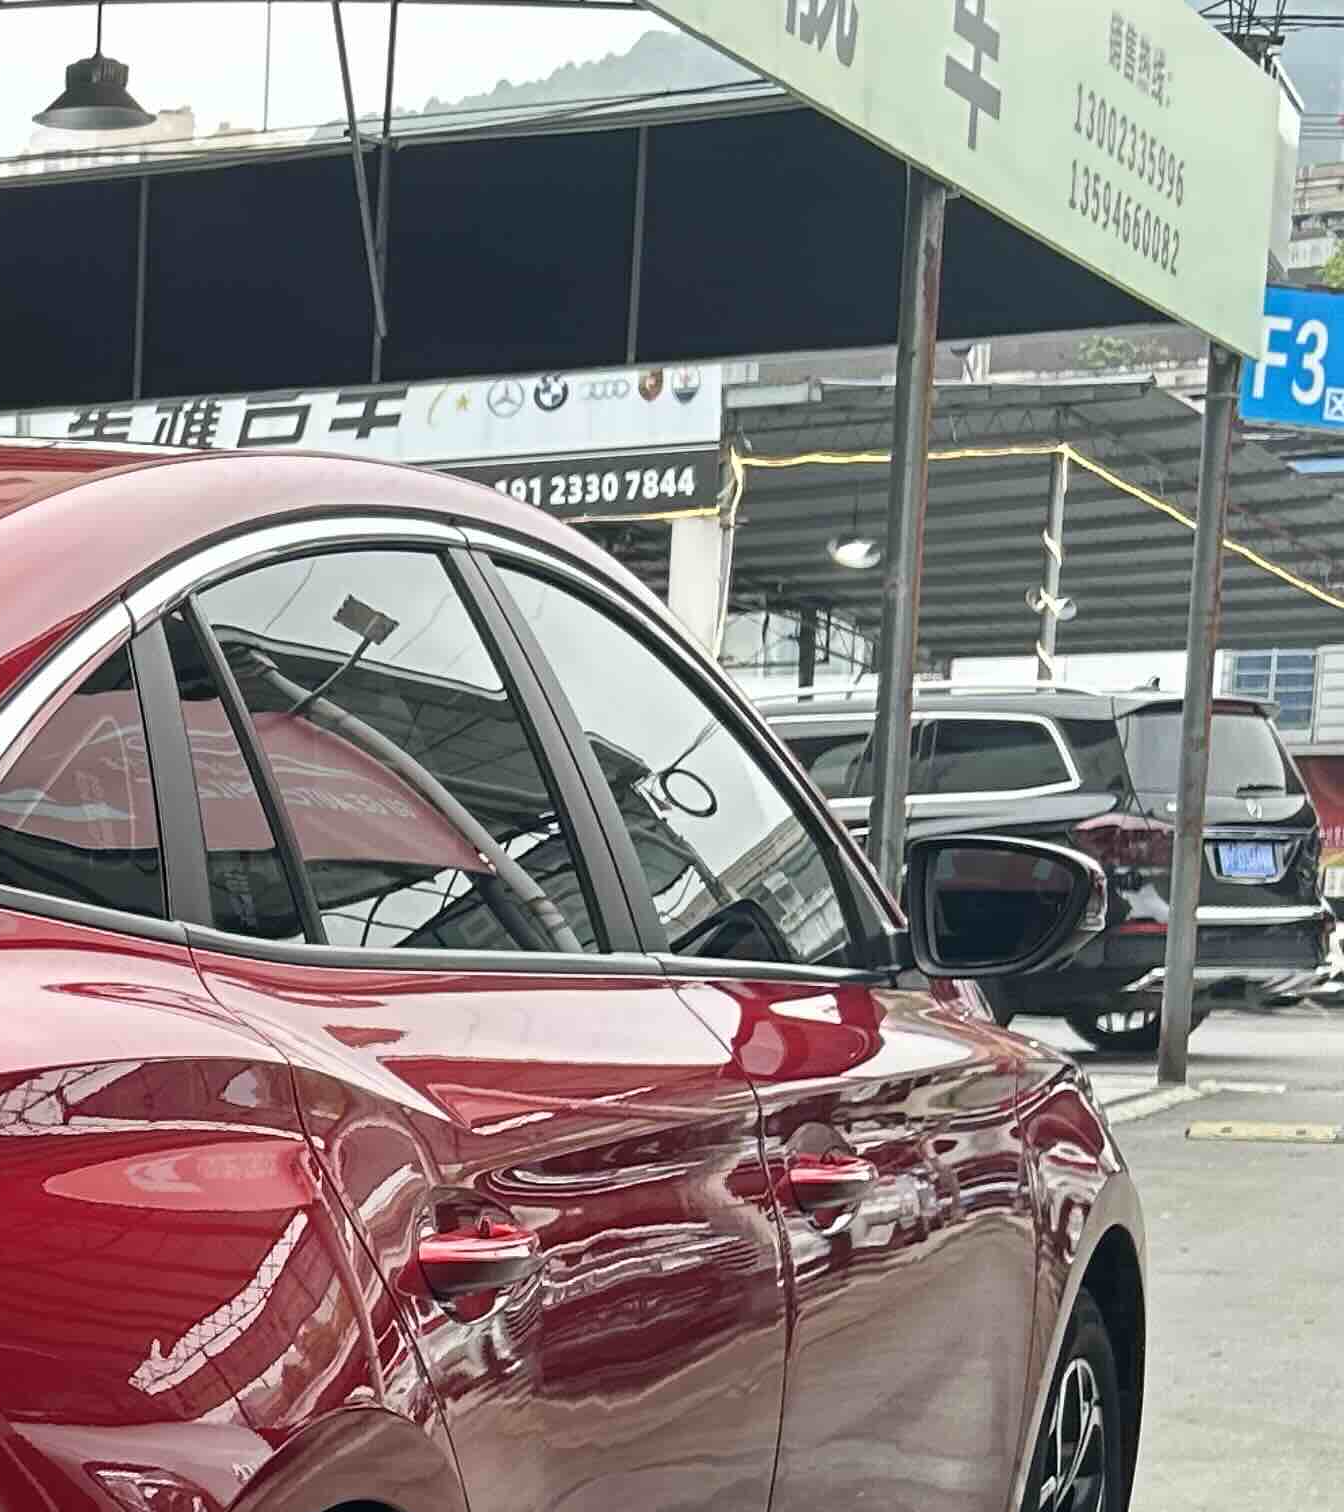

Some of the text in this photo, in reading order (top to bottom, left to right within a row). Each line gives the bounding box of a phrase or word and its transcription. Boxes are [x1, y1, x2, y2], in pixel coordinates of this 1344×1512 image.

[1074, 82, 1185, 208] 13002335996
[1069, 158, 1180, 277] 13594660082
[548, 470, 619, 506] 2330
[624, 464, 696, 501] 7844
